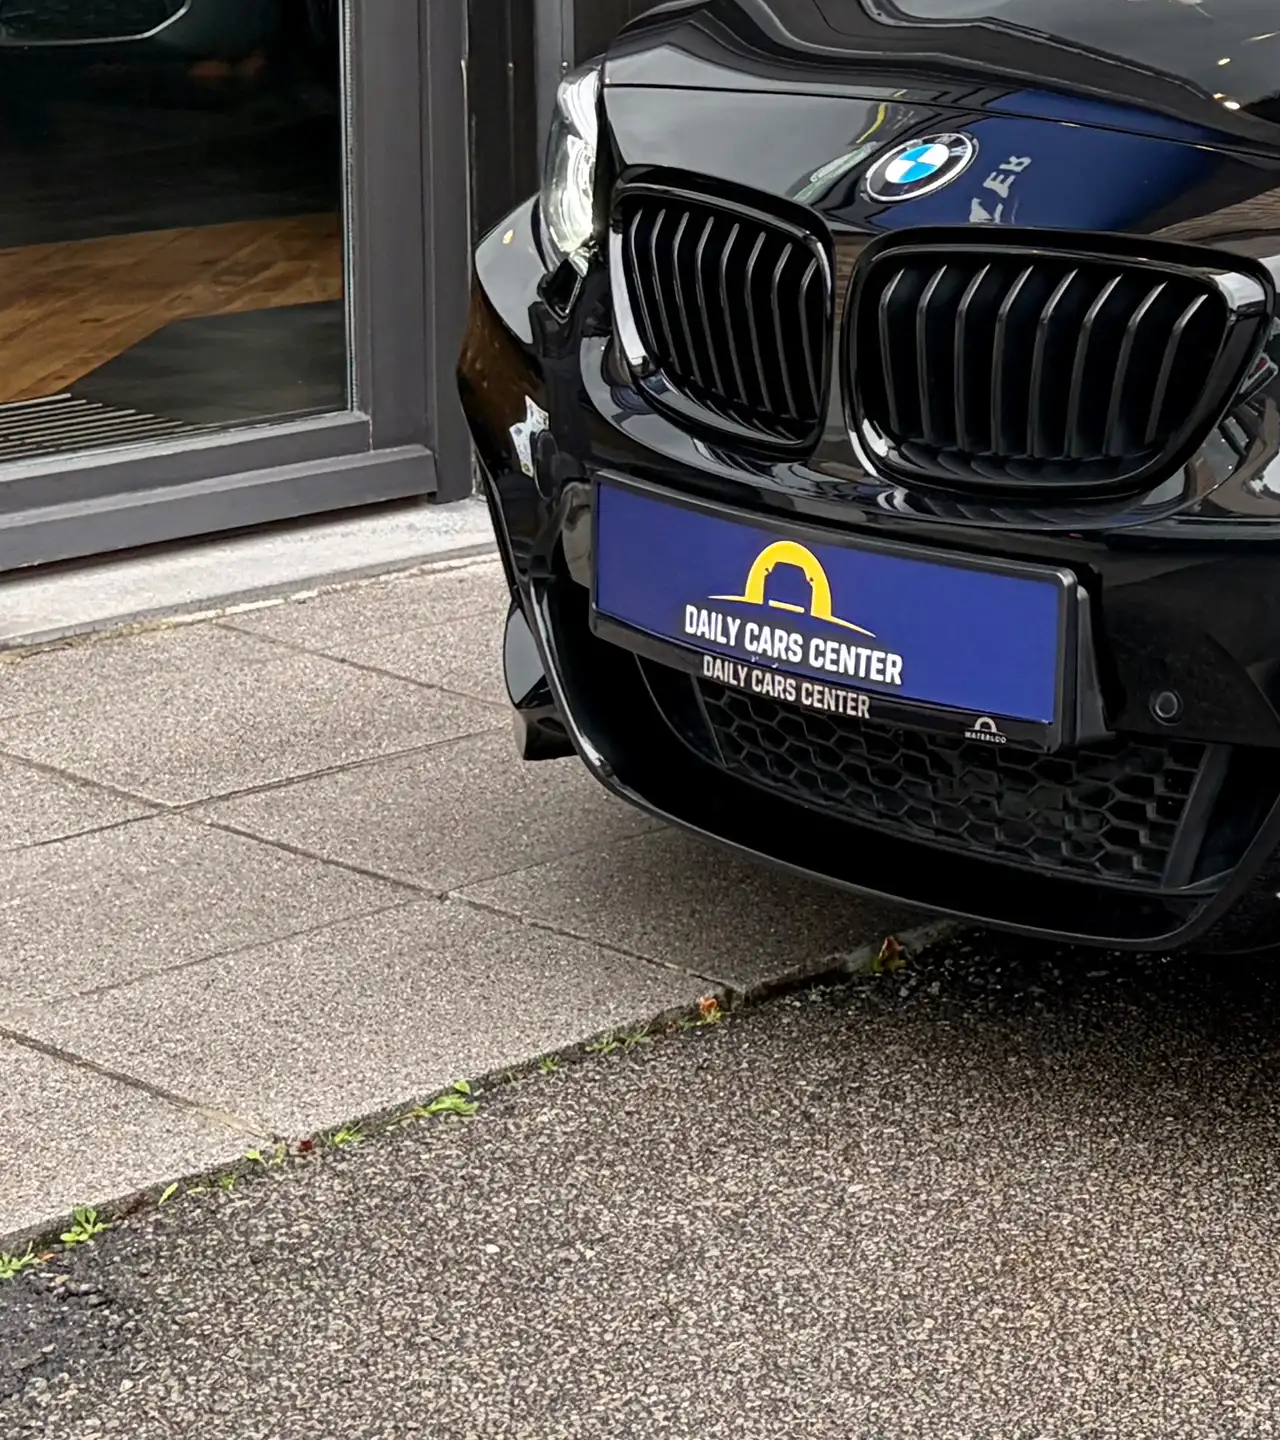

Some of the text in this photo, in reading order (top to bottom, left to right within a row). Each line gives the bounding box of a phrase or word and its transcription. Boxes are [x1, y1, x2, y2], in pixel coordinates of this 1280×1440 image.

[685, 604, 903, 685] DAILY CARS CENTER
[703, 655, 870, 719] DAILY CARS CENTER
